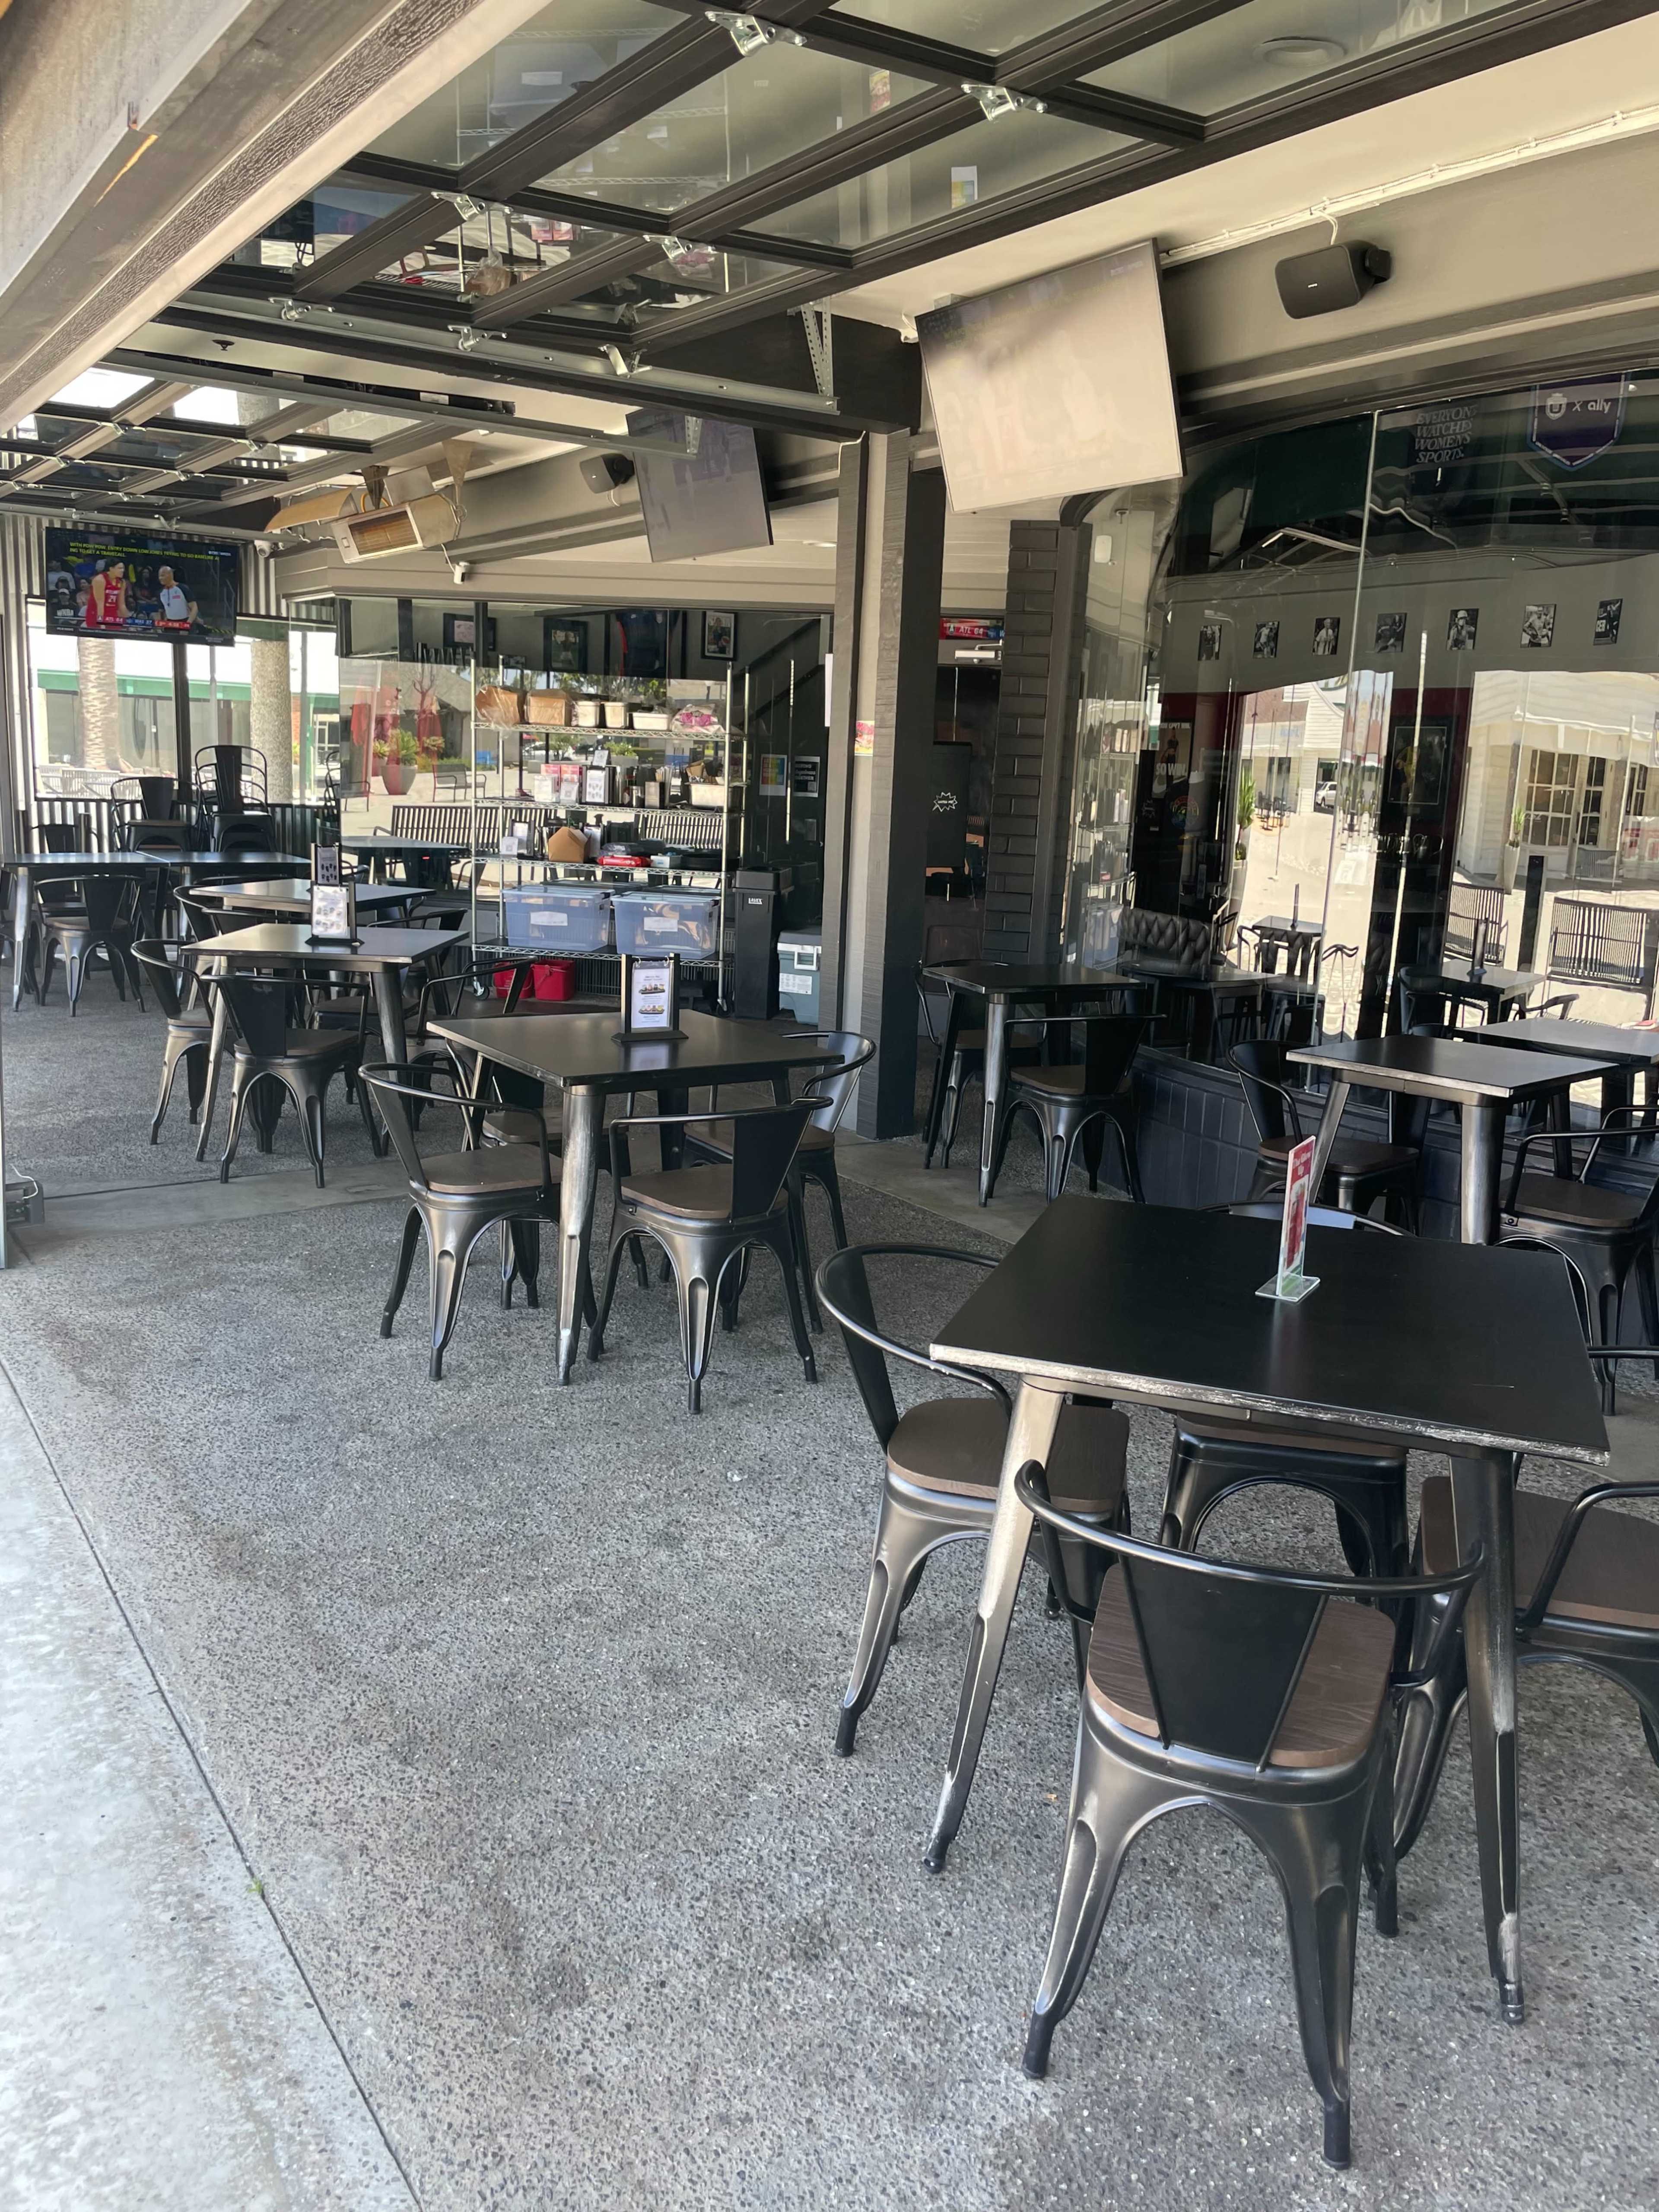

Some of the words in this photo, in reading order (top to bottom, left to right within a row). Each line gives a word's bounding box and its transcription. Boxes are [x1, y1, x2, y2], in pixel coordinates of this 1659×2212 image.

[1588, 398, 1611, 413] ally
[1417, 404, 1478, 424] EVERYONE
[1417, 419, 1474, 437] WATCHES
[1156, 763, 1167, 776] SO
